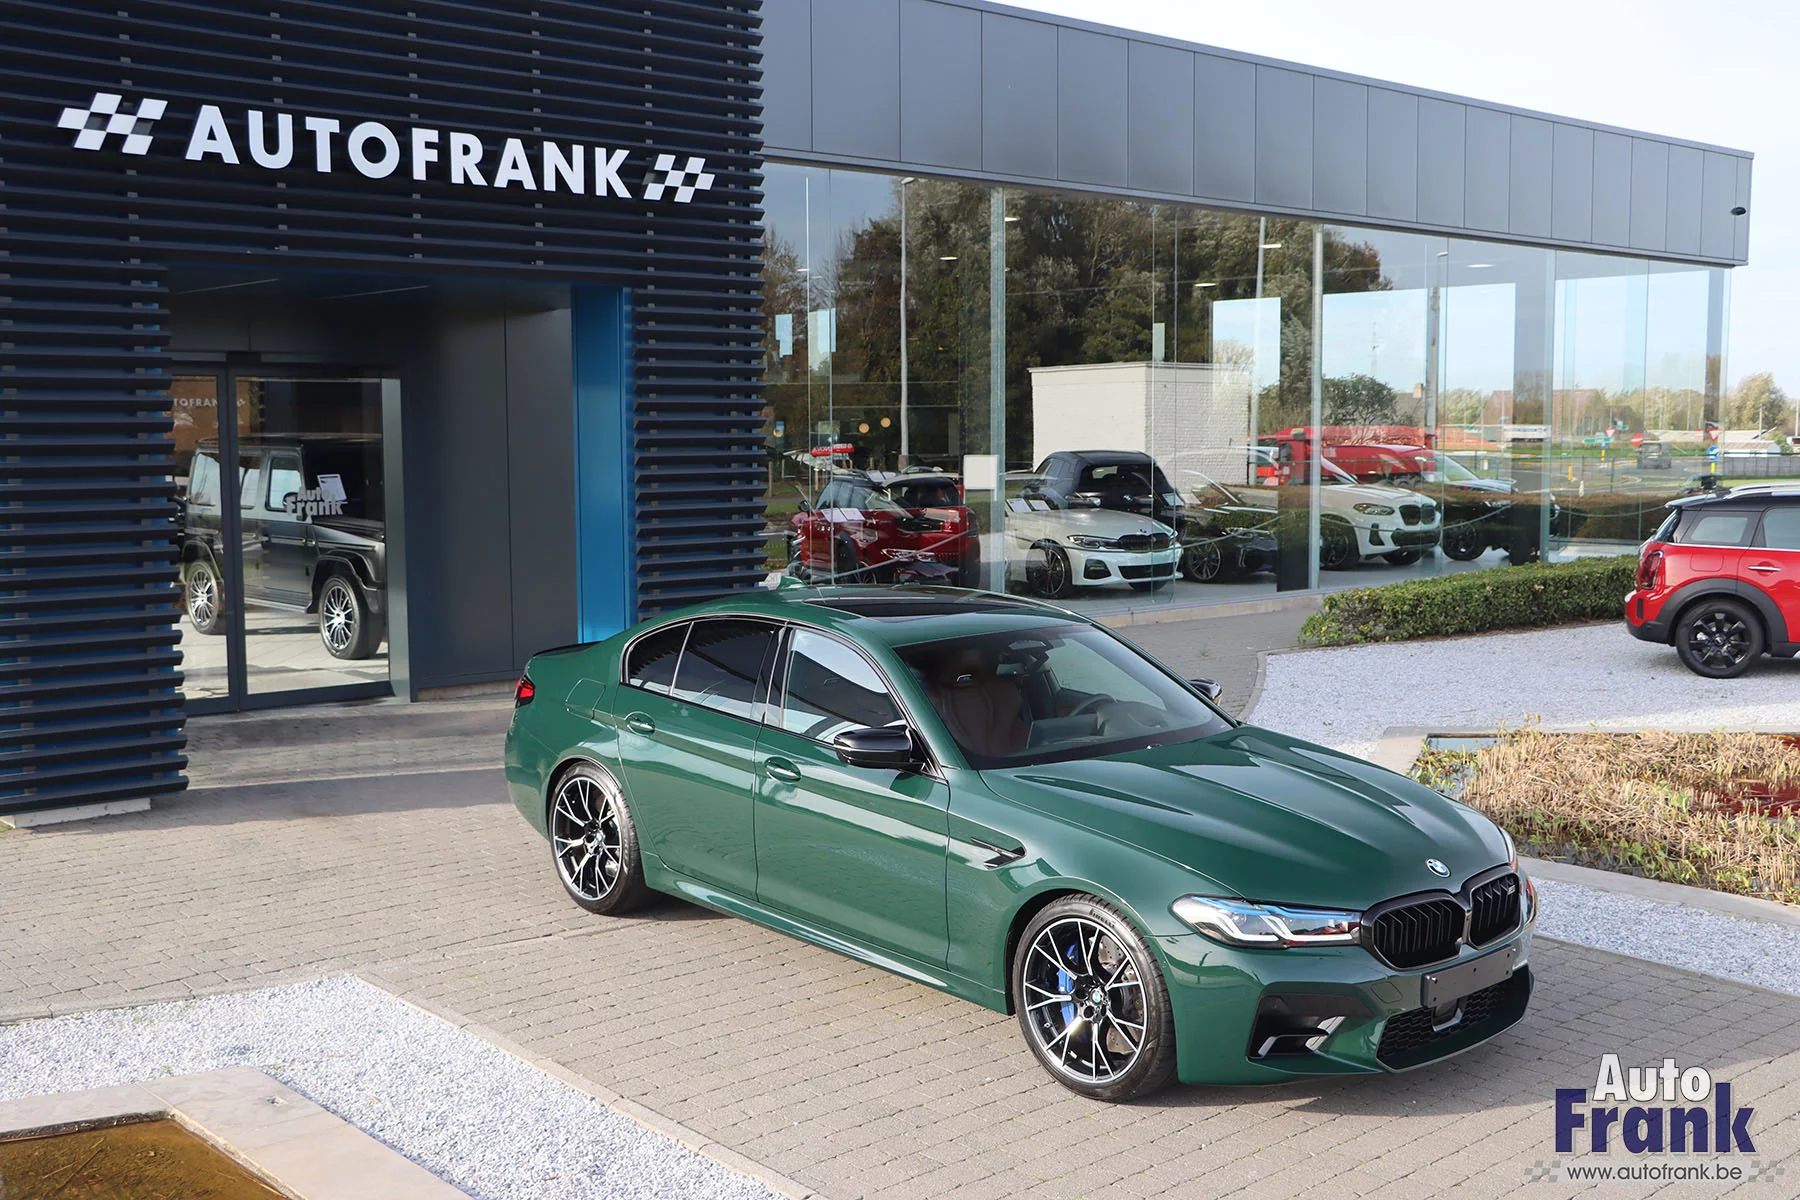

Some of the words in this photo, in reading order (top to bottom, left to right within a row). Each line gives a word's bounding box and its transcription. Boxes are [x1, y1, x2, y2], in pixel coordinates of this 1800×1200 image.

[185, 104, 632, 199] AUTOFRANK
[173, 398, 218, 408] TOFRAN
[285, 494, 344, 516] Frank
